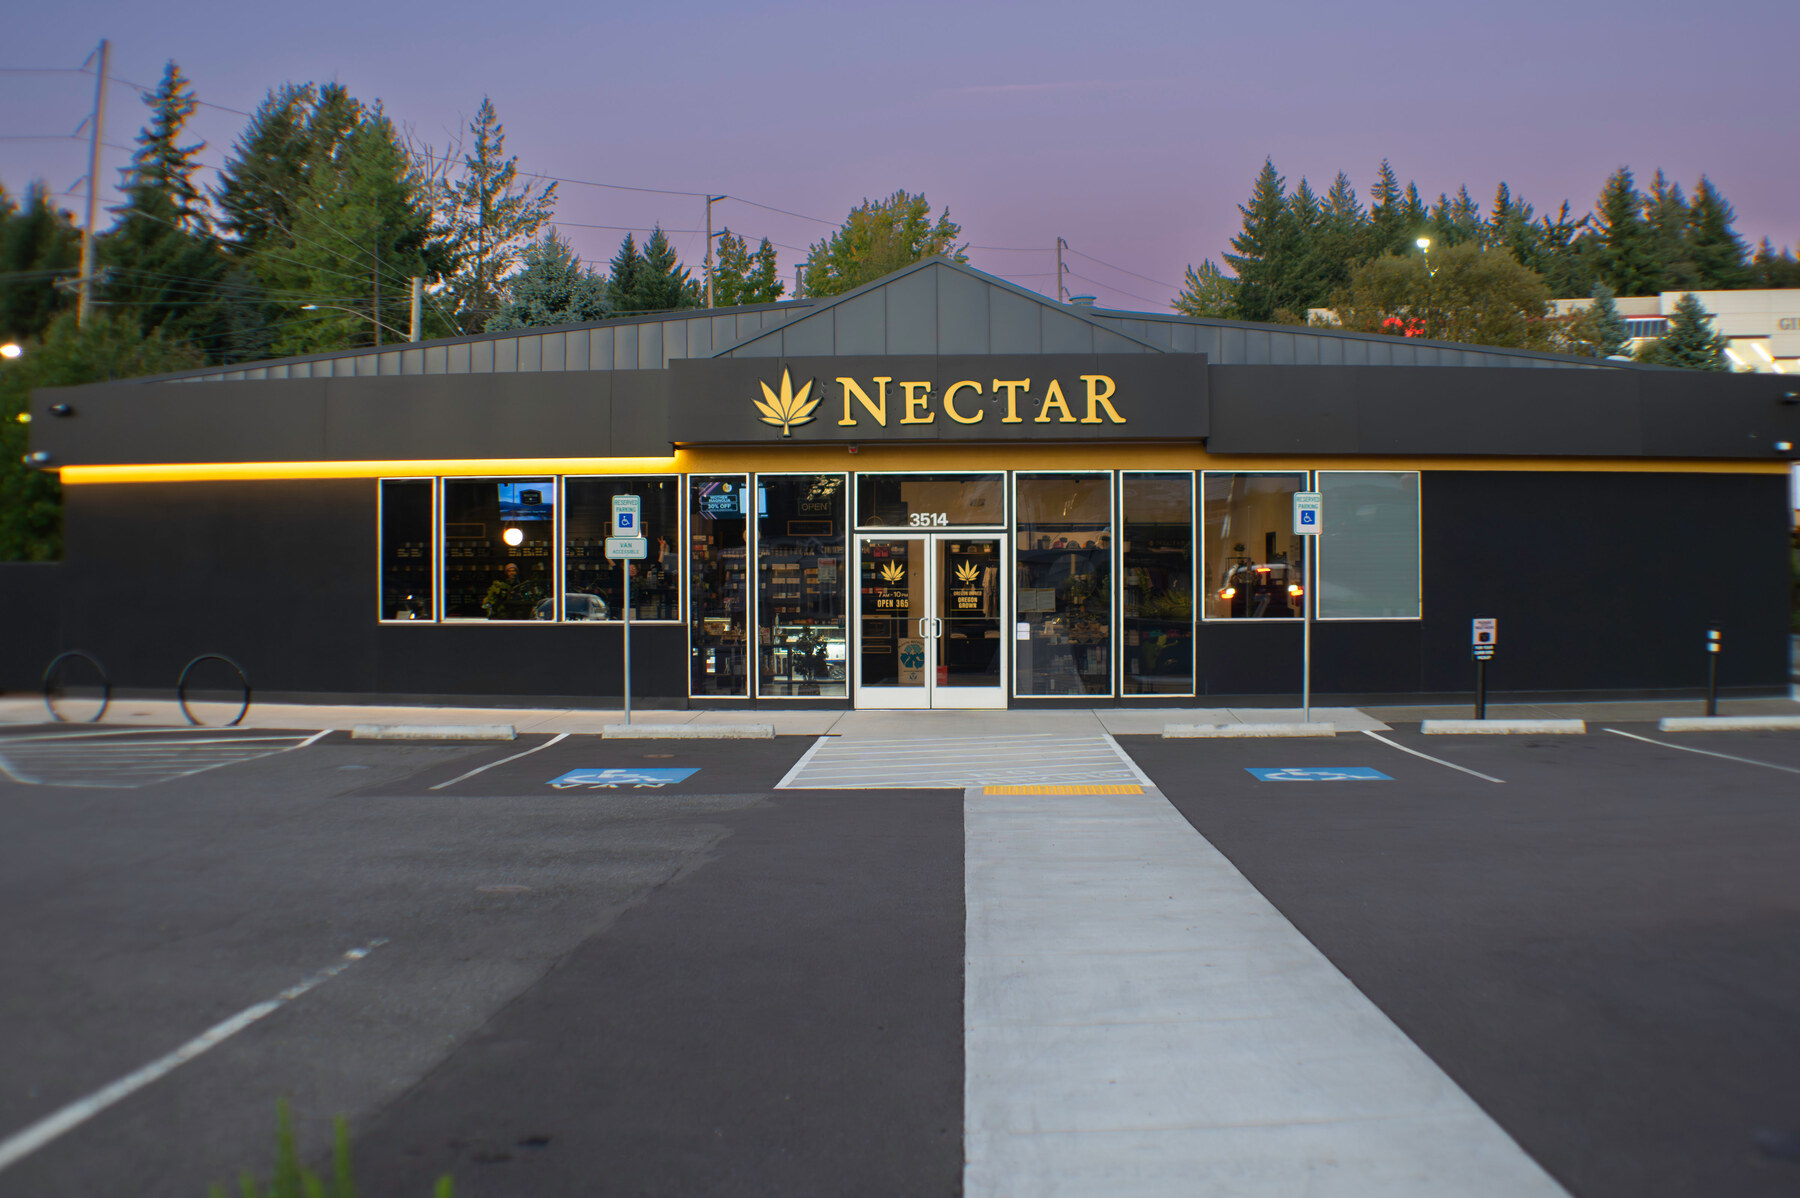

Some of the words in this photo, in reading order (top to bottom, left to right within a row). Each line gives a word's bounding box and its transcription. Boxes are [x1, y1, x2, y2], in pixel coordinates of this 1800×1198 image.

[835, 374, 1127, 427] NECTAR
[801, 502, 828, 511] OPEN
[909, 512, 949, 527] 3514
[877, 599, 894, 608] OPEN
[895, 599, 909, 608] 365
